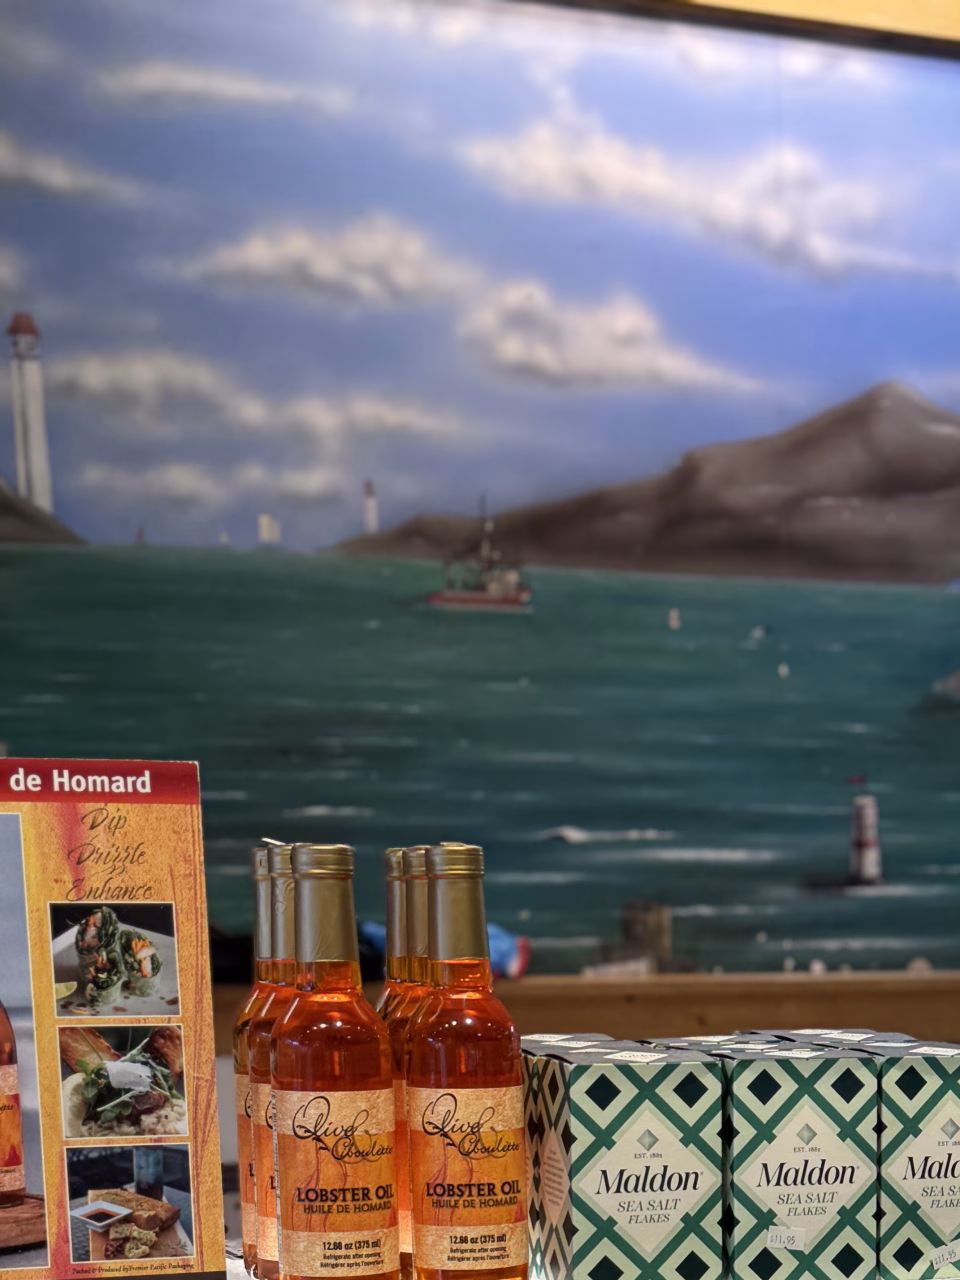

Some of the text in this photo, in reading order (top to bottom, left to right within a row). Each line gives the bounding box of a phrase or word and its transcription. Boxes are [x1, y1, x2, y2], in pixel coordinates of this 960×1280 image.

[9, 768, 152, 793] de Homard
[81, 803, 127, 836] Dip
[67, 837, 147, 875] Drizzle
[66, 877, 153, 901] Enhance
[293, 1096, 355, 1140] Olive
[422, 1093, 480, 1136] Olive
[595, 1165, 700, 1195] Maldon
[756, 1158, 856, 1188] Maldon
[296, 1183, 395, 1203] LOBSTER OIL
[426, 1179, 522, 1198] LOBSTER OIL
[921, 1185, 945, 1198] SEA
[431, 1195, 518, 1209] HUILE DE HOMARD
[617, 1198, 681, 1213] SEA SALT
[776, 1191, 838, 1206] SEA SALT
[303, 1200, 392, 1215] HUILE DE HOMARD
[786, 1206, 828, 1217] FLAKES
[628, 1213, 671, 1225] FLAKES
[323, 1241, 343, 1251] 12.68
[344, 1242, 354, 1251] oz
[355, 1239, 371, 1251] (375
[449, 1234, 496, 1245] 12.68 oz (375
[769, 1234, 796, 1246] $11.95
[934, 1249, 957, 1266] $11.95
